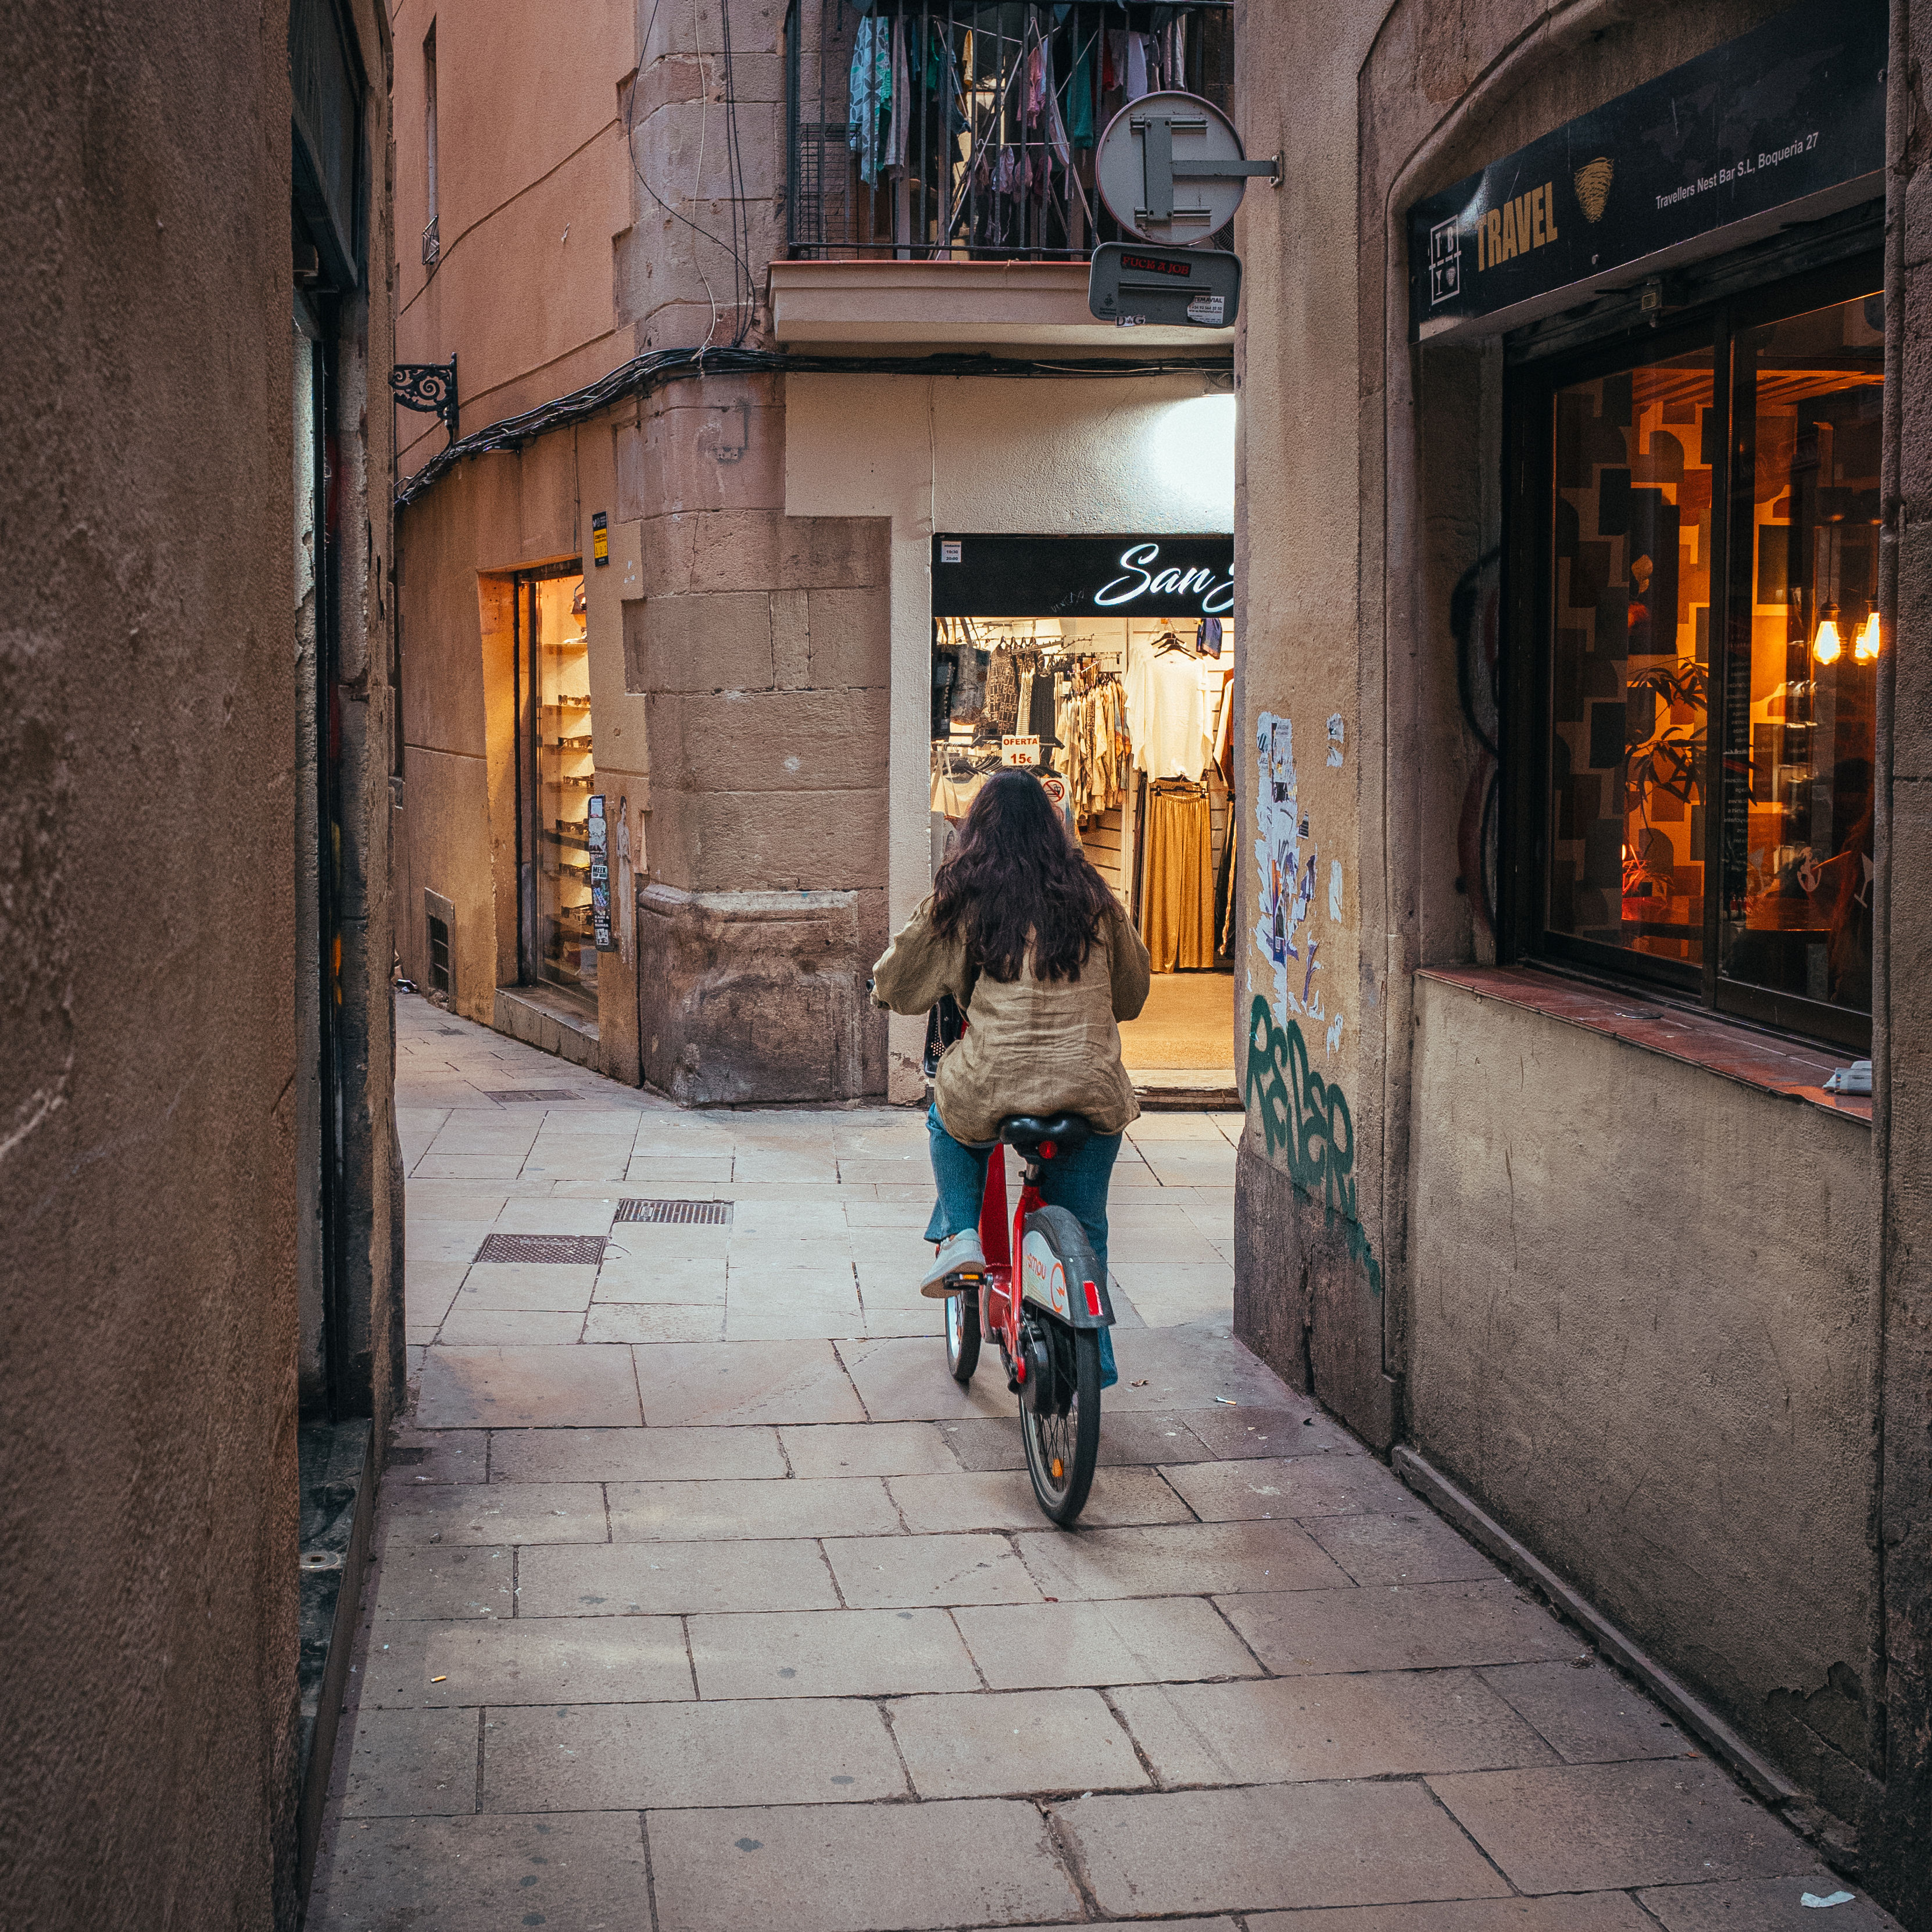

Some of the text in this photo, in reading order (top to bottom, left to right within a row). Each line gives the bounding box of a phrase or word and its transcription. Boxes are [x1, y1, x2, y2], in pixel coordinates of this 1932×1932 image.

[1656, 184, 1695, 209] Travellers
[1697, 172, 1717, 193] Nest
[1719, 168, 1736, 184] Bar
[1758, 140, 1803, 169] Boqueria
[1806, 131, 1819, 151] 27
[1477, 181, 1558, 272] TRAVEL
[1123, 256, 1189, 275] FUCK A JOB
[1094, 543, 1215, 606] San
[1003, 738, 1038, 746] OFERTA
[1010, 753, 1032, 764] 15€
[1026, 1253, 1047, 1280] smou
